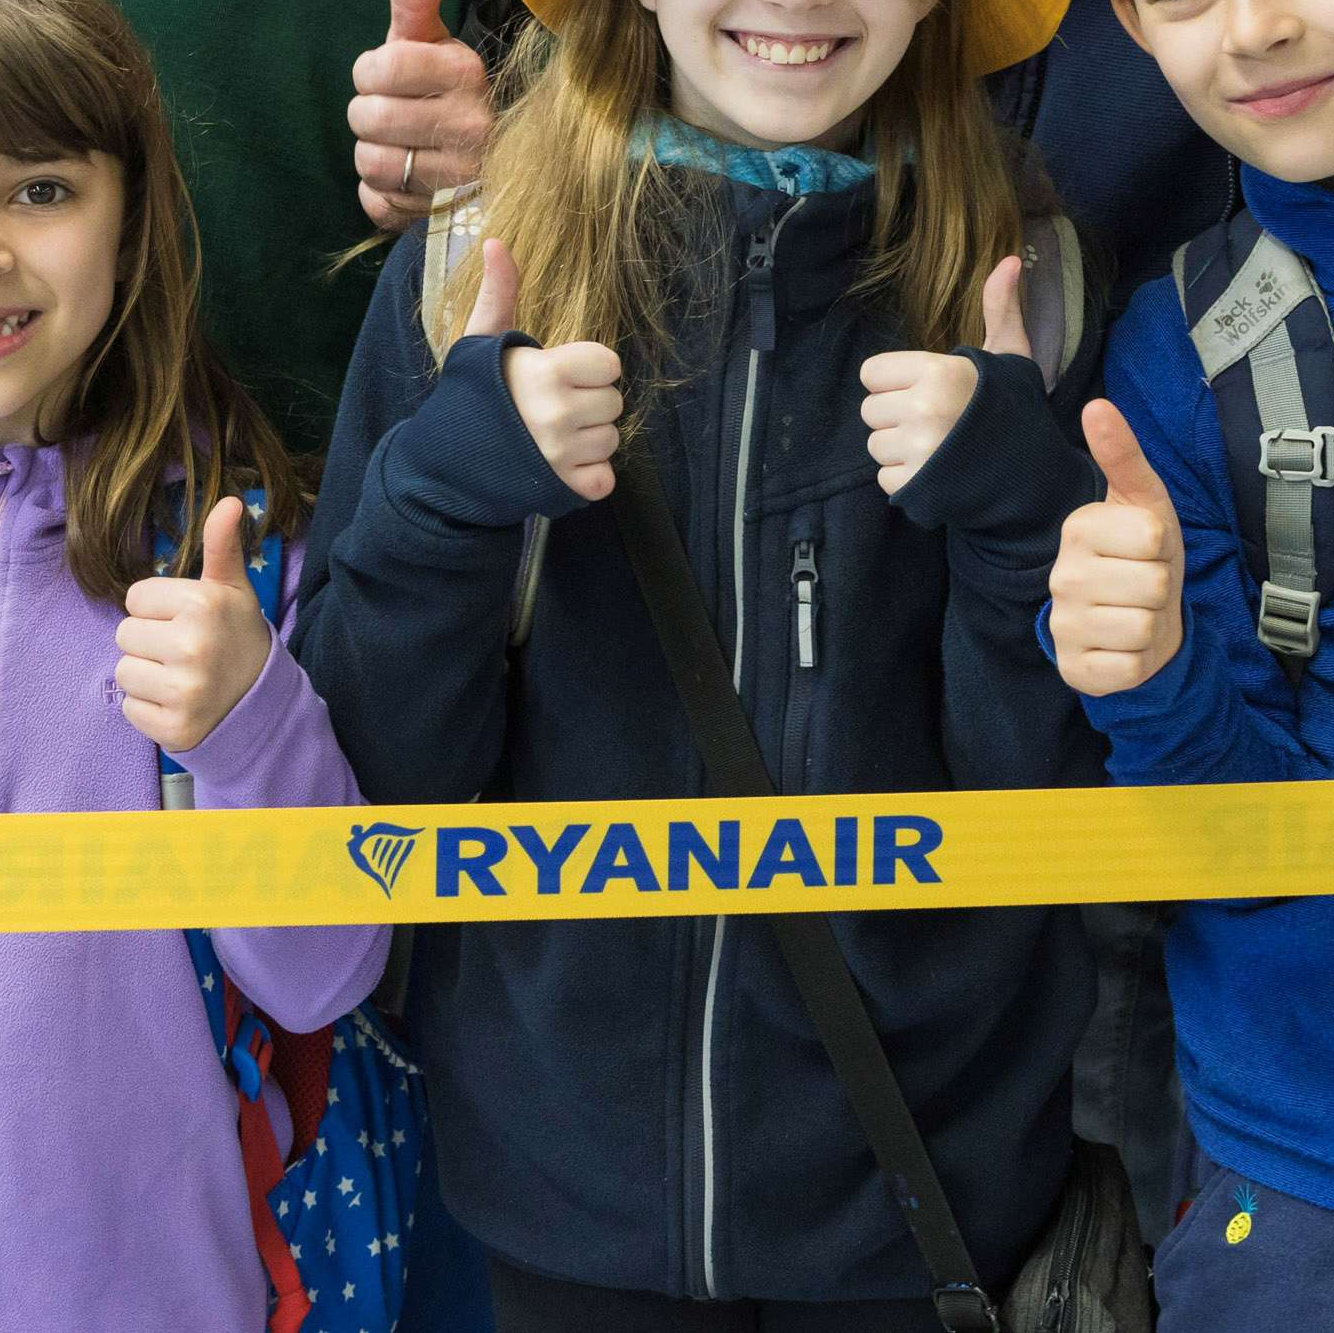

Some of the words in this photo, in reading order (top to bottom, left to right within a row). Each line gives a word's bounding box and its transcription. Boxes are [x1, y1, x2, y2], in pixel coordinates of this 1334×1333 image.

[1213, 295, 1252, 335] Jack
[1217, 281, 1292, 346] Wolfskin
[436, 816, 942, 897] RYANAIR
